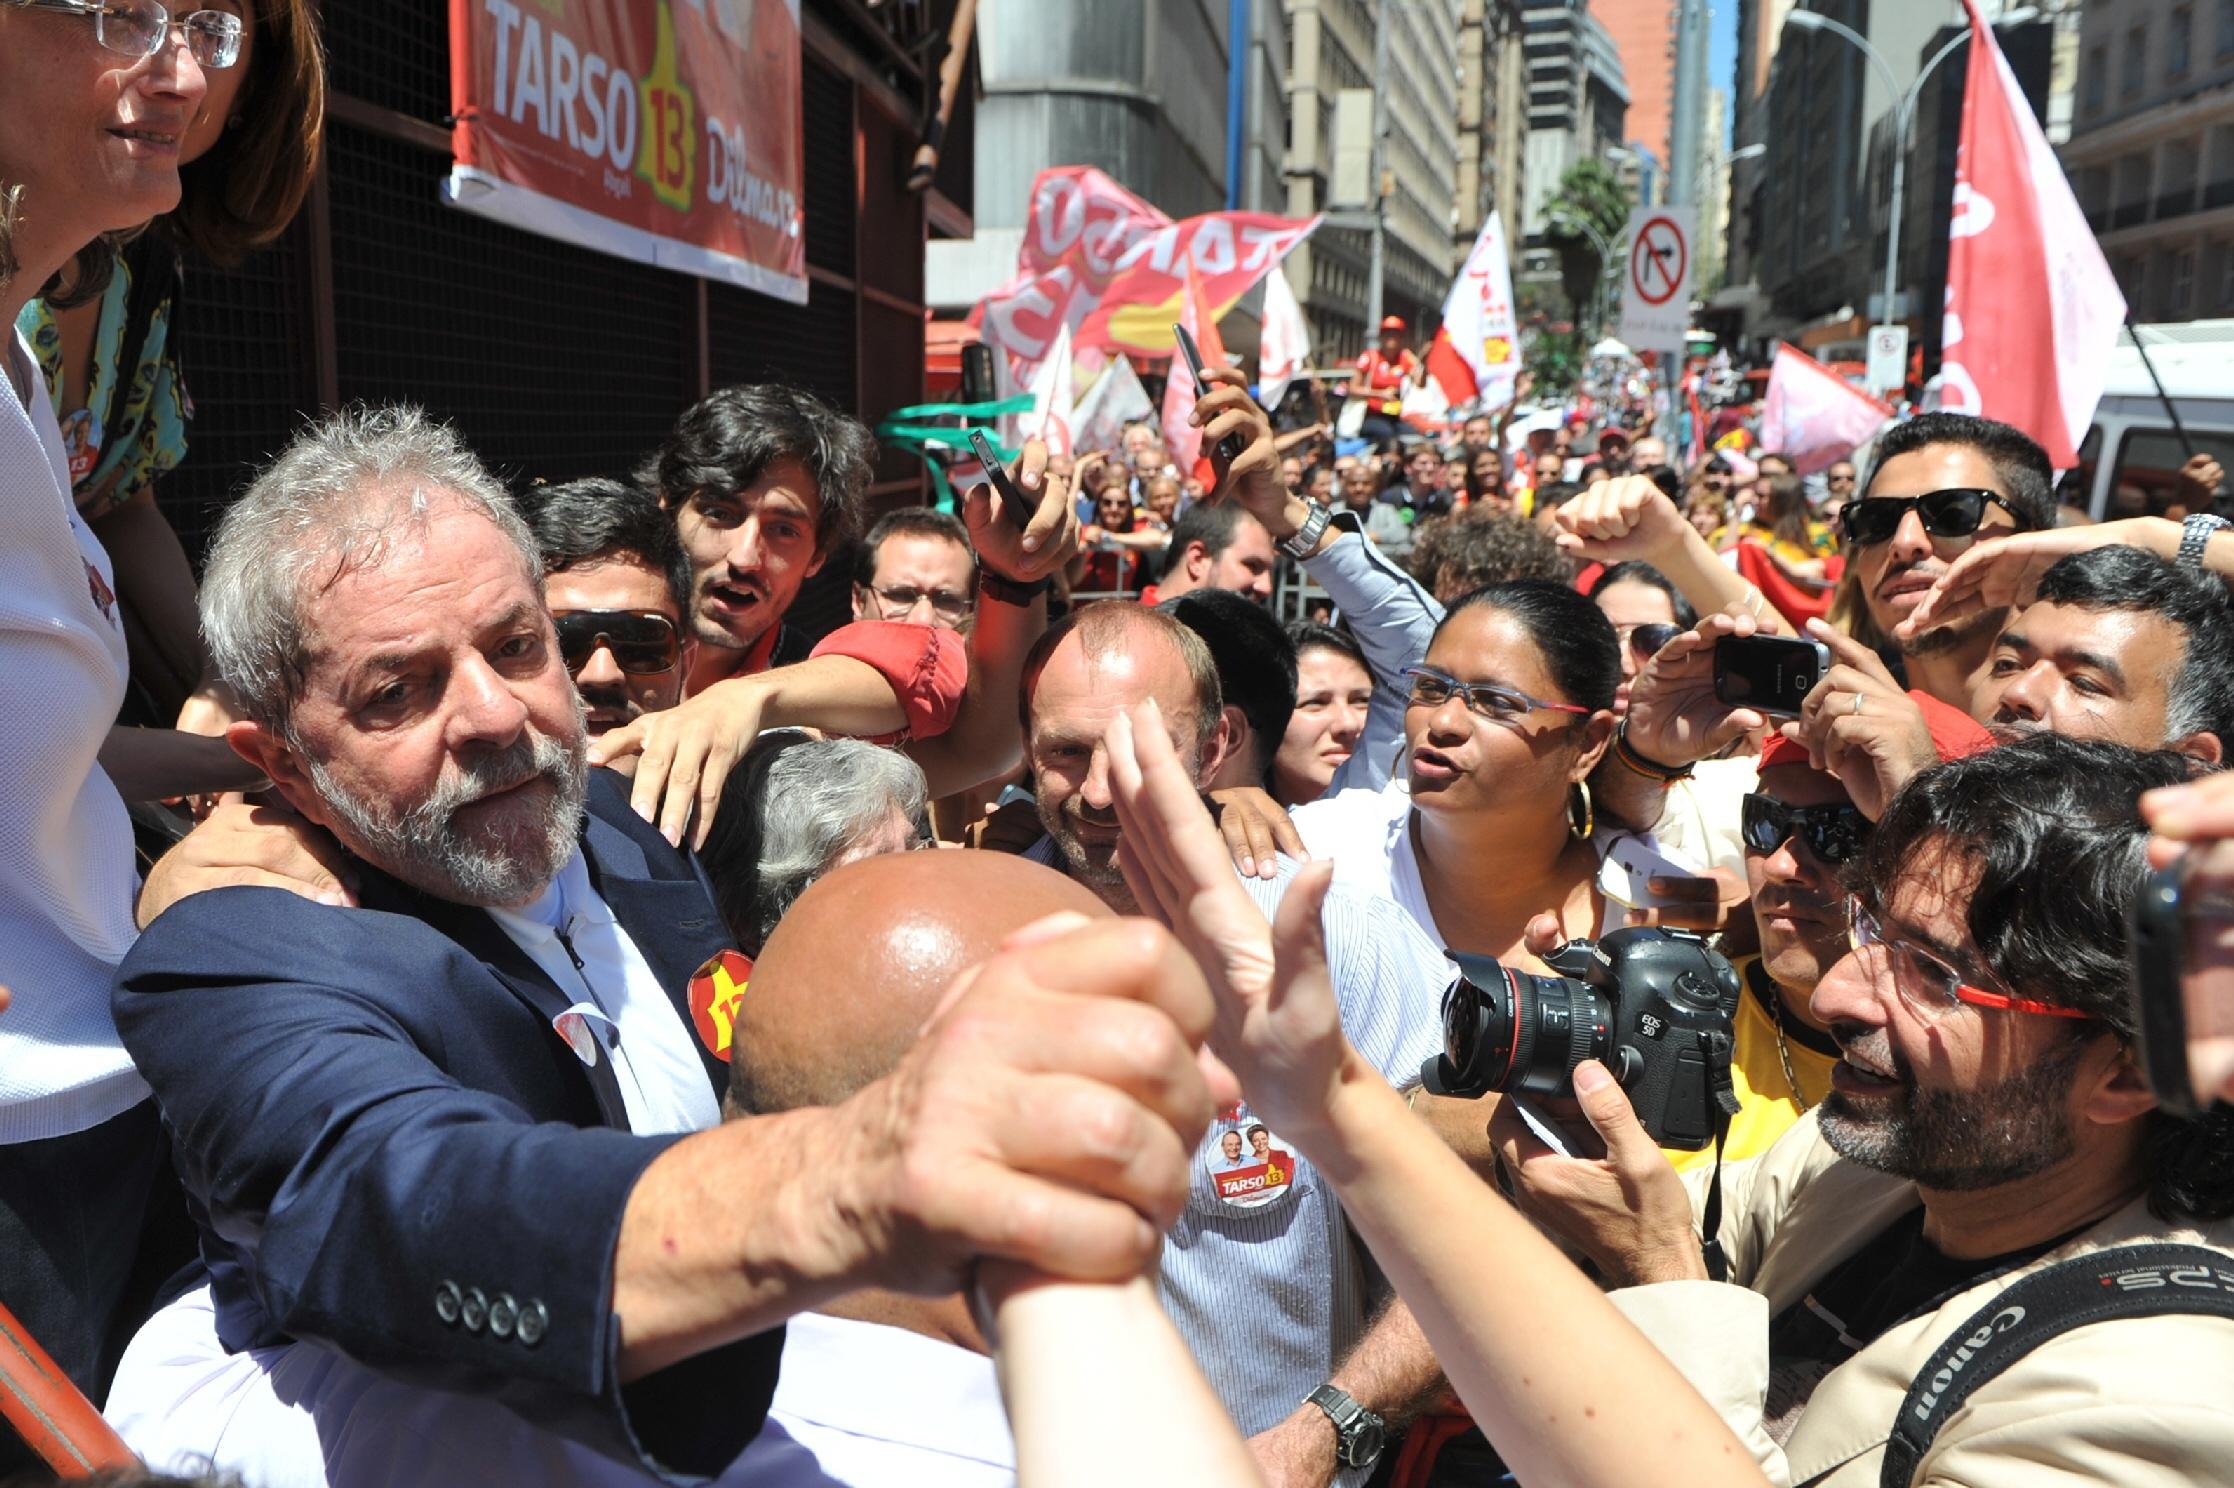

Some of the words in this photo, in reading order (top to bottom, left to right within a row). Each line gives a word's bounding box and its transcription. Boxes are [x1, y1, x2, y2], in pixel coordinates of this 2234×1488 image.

[485, 0, 637, 171] TARSO
[649, 87, 687, 191] 13
[1641, 1014, 1662, 1028] EOS
[1641, 1025, 1656, 1037] 5D
[1222, 1174, 1266, 1195] TARSO
[1268, 1172, 1281, 1183] 13
[1914, 1306, 2027, 1421] Canon
